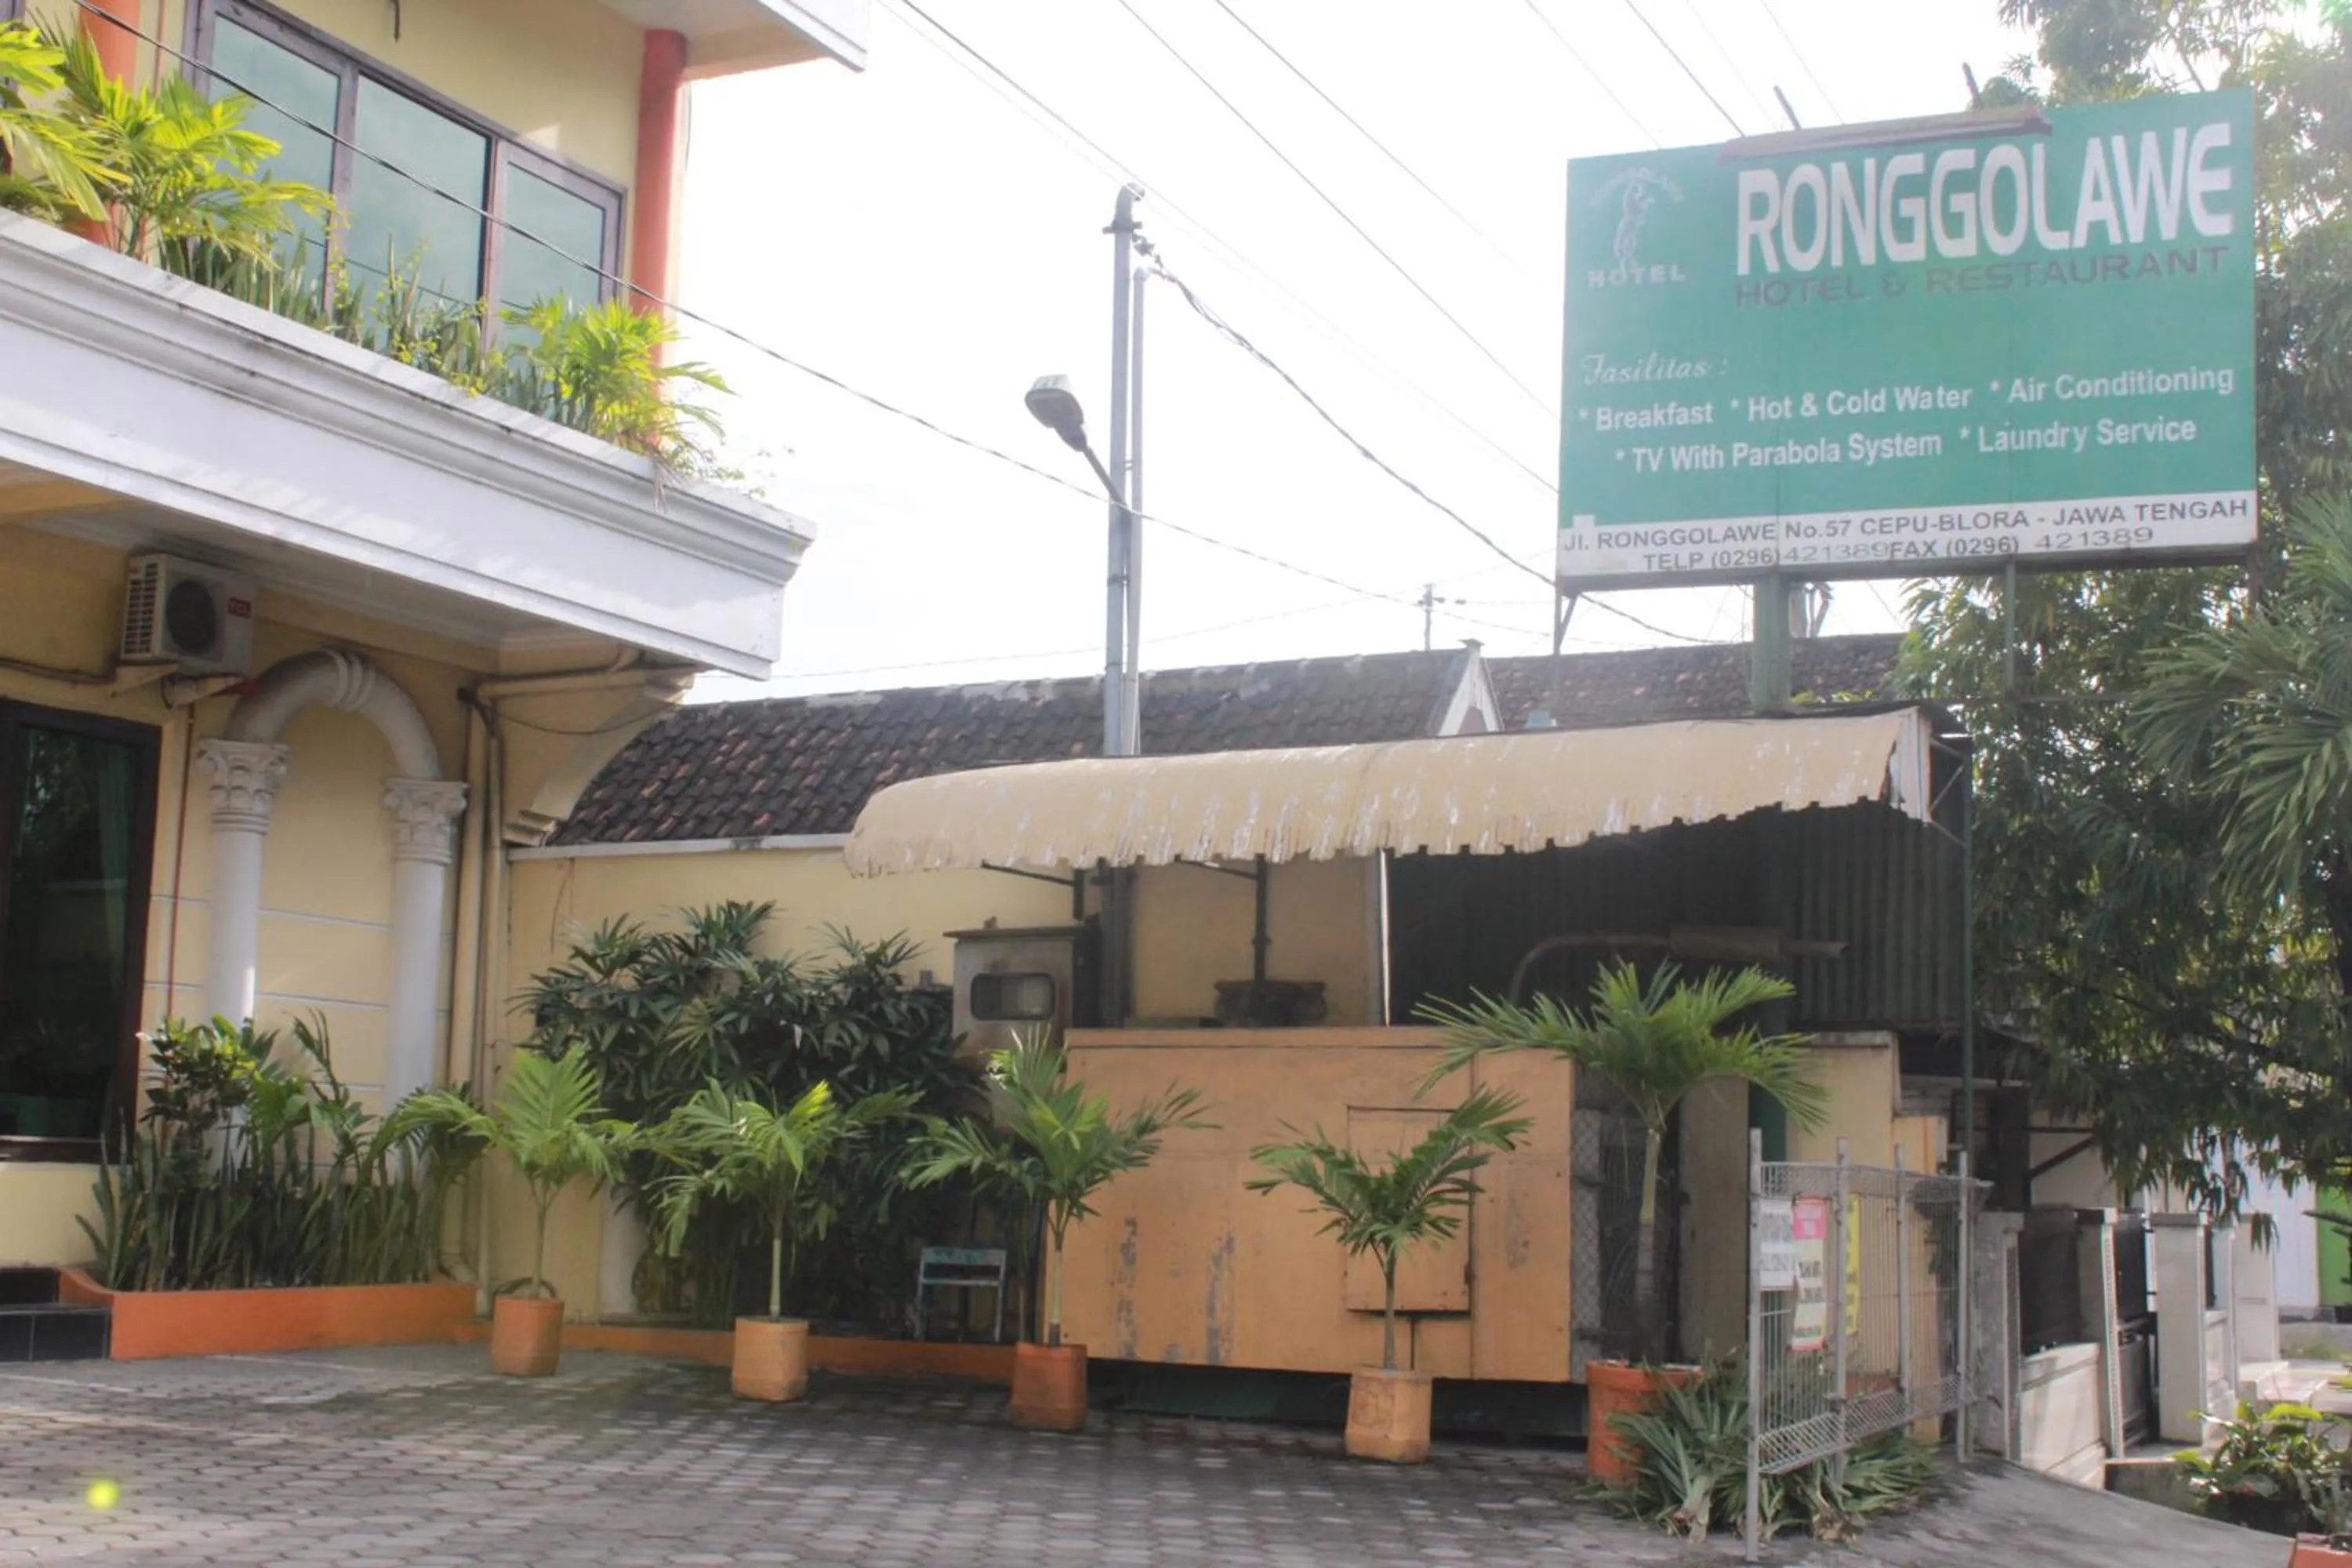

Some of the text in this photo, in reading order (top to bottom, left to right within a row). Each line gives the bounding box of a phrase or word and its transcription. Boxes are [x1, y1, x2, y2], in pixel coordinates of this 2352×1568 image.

[1737, 122, 2232, 275] RONGGOLAWE
[1586, 263, 1687, 289] HOTEL
[1736, 246, 2228, 307] HOTEL & RESTAURANT
[1581, 352, 1711, 386] Fasilitas
[1595, 365, 2234, 431] Breakfast Hot & Cold Water Air Conditioning
[1632, 416, 2197, 473] TV With Parabola System Laundry Service
[1597, 521, 1777, 549] RONGGOLAWE
[1785, 519, 1852, 540] No.57
[1860, 510, 2029, 536] CEPU-BLORA
[2053, 505, 2125, 526] JAWA
[2133, 499, 2248, 522] TENGAH
[1642, 552, 1704, 572] TELP
[1946, 535, 2019, 557] (0296)
[2034, 527, 2154, 550] 421389
